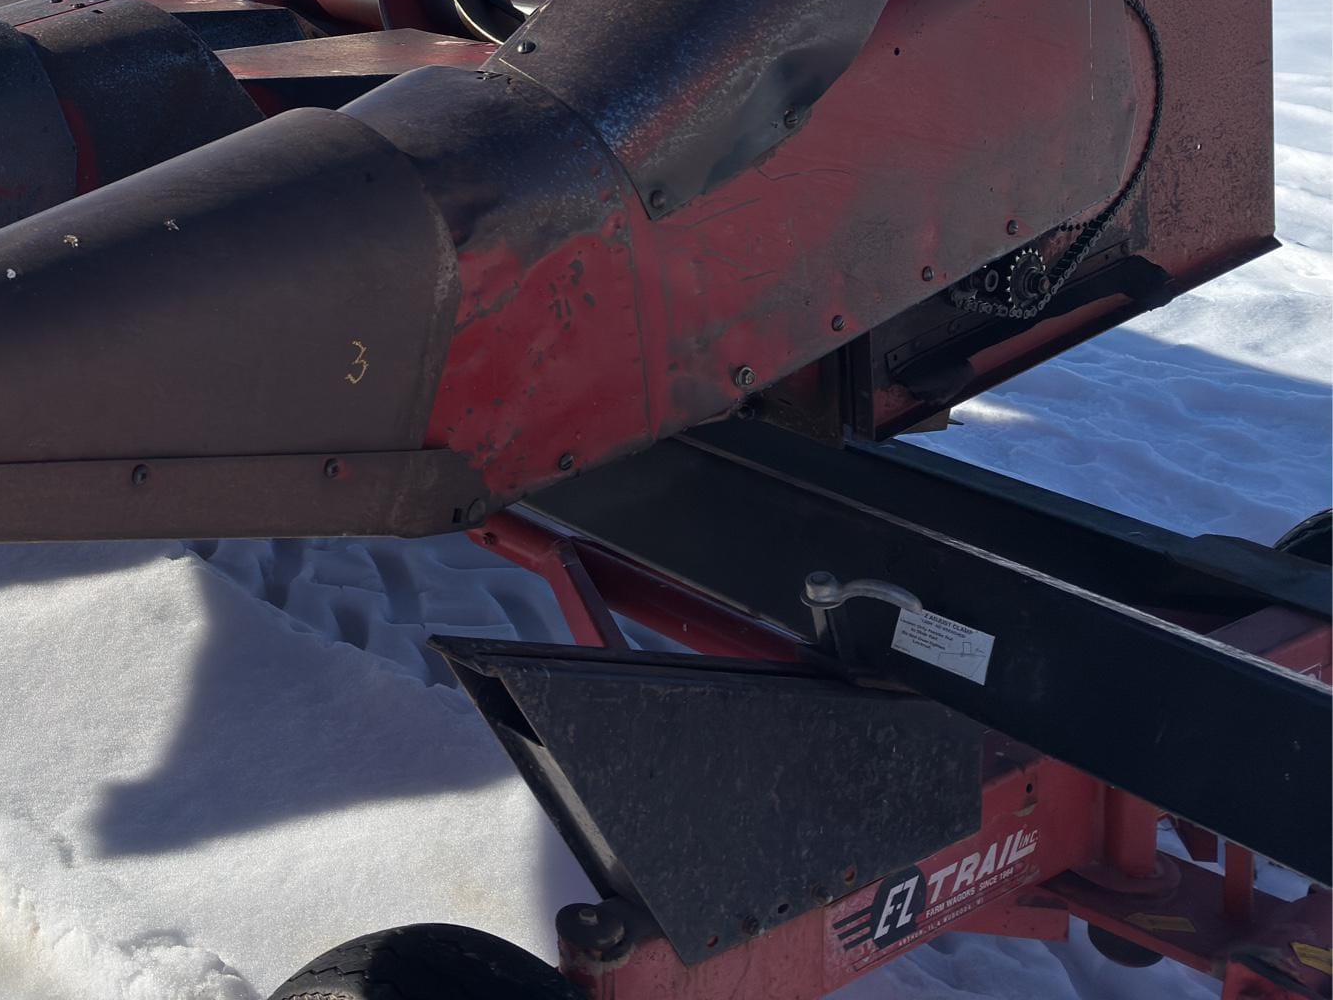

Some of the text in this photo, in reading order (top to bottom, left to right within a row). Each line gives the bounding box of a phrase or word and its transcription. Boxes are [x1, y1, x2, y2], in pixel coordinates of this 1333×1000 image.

[344, 340, 369, 385] 3
[874, 874, 920, 941] E-Z
[927, 829, 1037, 905] TRAIL
[925, 902, 945, 918] FARM
[946, 887, 976, 908] WAGONS
[978, 876, 998, 891] SINCE
